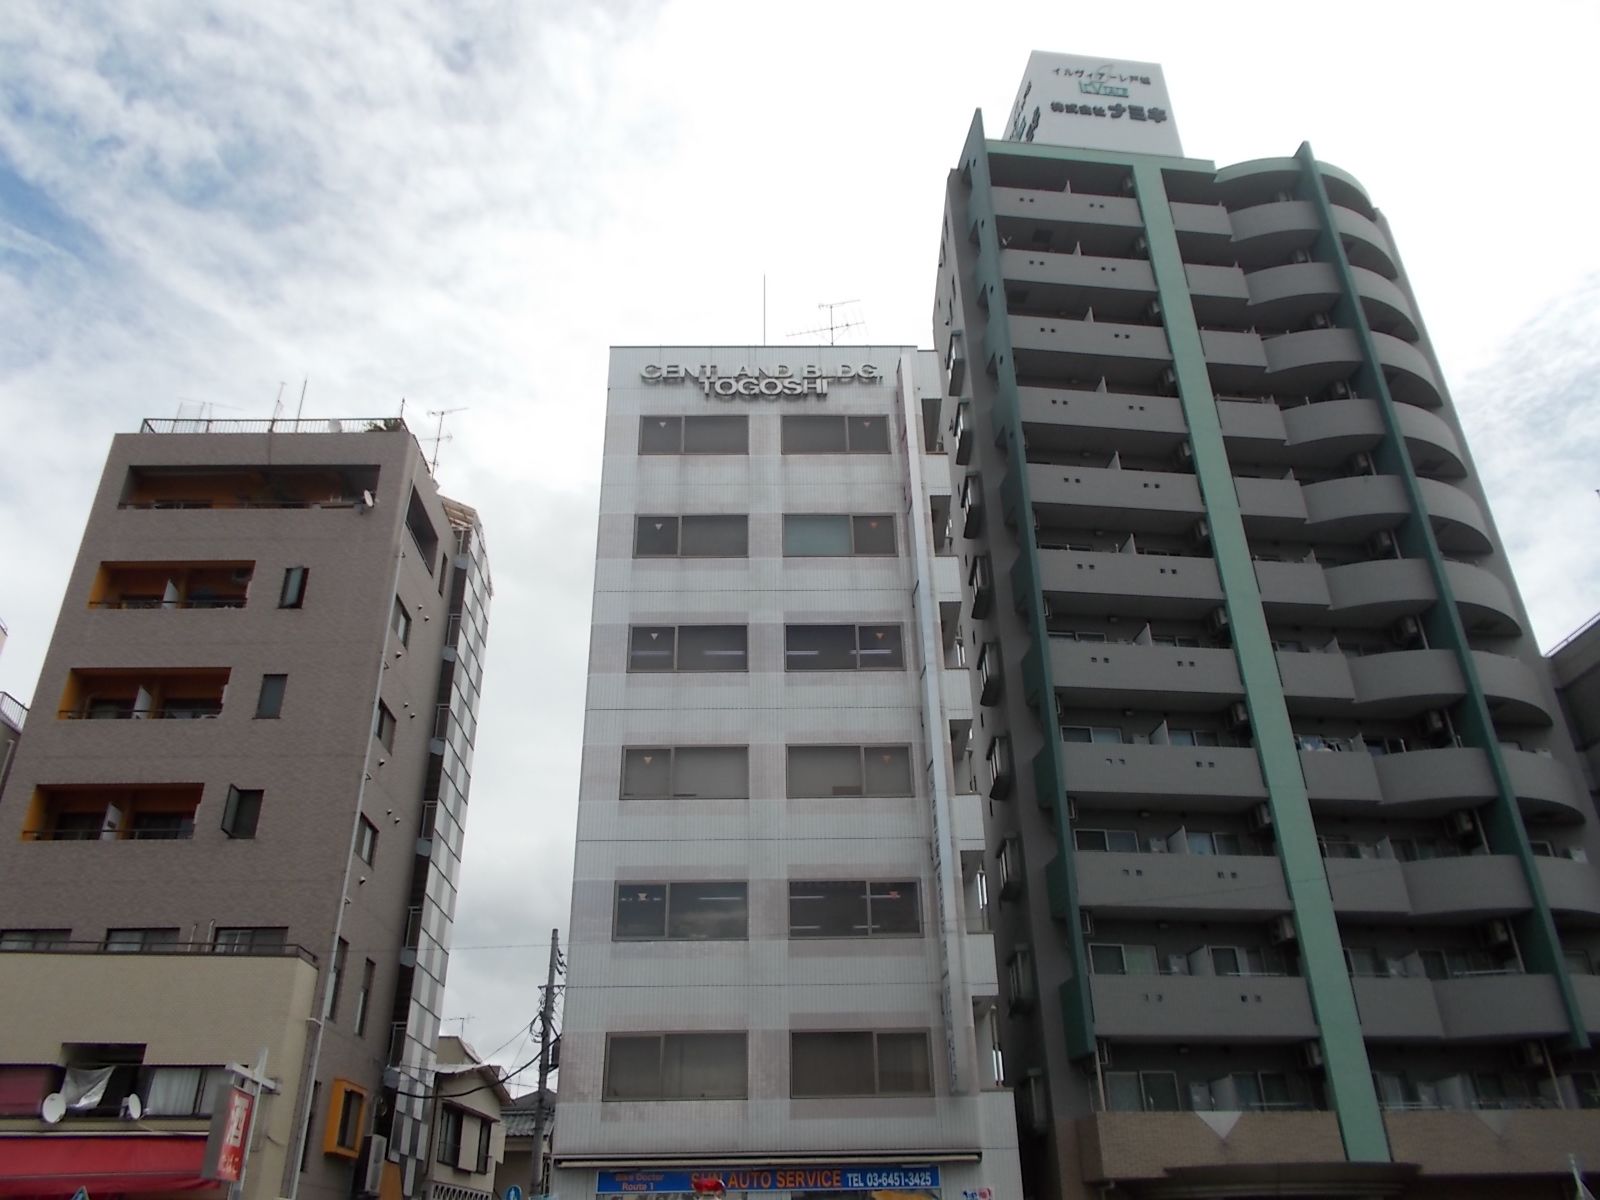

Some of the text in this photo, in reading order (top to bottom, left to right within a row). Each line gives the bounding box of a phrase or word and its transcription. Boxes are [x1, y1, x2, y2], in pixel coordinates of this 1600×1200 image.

[699, 377, 829, 397] TOGOSHI
[622, 1181, 648, 1191] Route
[728, 1171, 771, 1188] AUTO
[776, 1170, 841, 1187] SERVICE
[847, 1172, 932, 1187] TEL 03-6451-3425
